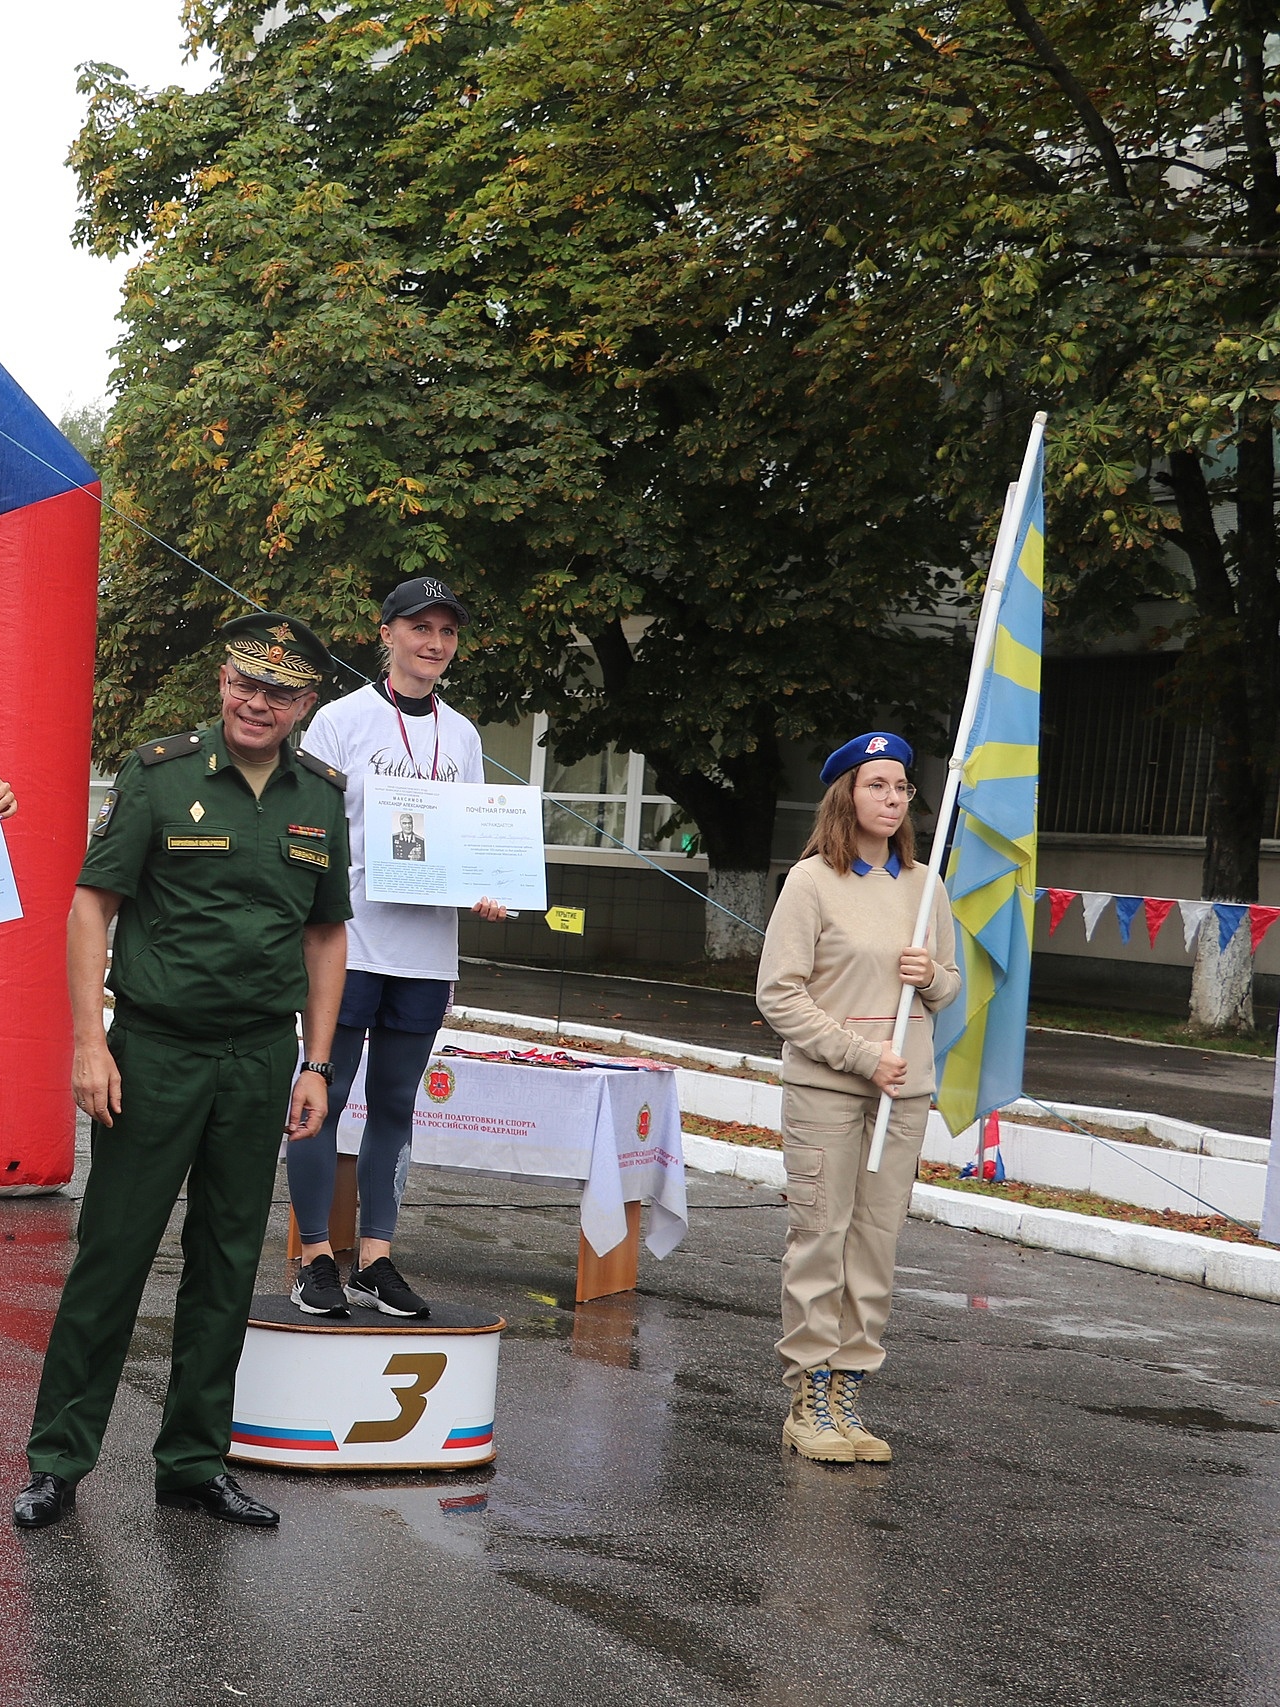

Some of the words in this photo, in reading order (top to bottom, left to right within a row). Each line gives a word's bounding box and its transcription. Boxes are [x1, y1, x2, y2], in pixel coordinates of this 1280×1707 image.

[423, 580, 446, 599] NY
[465, 806, 498, 814] ПОЧЁТНАЯ
[428, 1120, 479, 1132] РОССИЙСКОЙ
[480, 1125, 528, 1136] ФЕДЕРАЦИИ
[444, 1113, 496, 1125] ПОДГОТОВКИ
[505, 1119, 536, 1129] СПОРТА
[343, 1352, 447, 1444] 3
